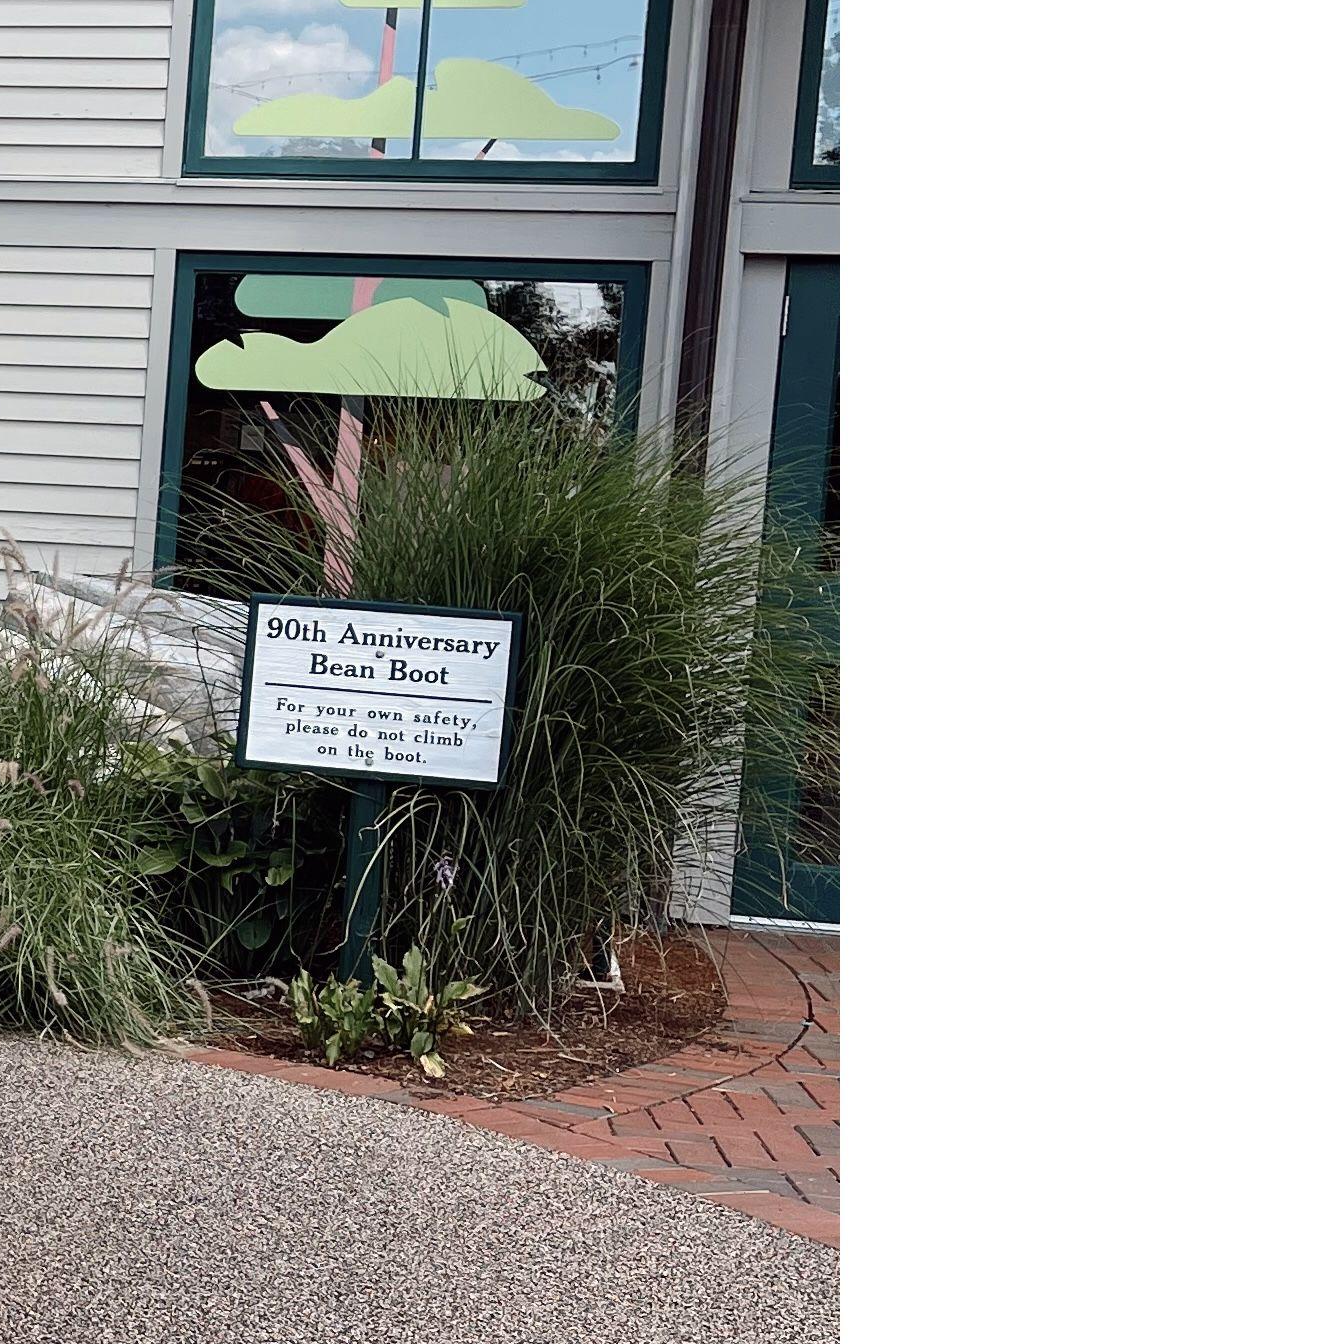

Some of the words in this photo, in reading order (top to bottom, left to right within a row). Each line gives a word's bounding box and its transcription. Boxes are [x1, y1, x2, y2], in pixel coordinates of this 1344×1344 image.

[266, 617, 327, 643] 90th
[338, 623, 500, 659] Anniversary
[309, 653, 375, 680] Bean
[388, 659, 449, 685] Boot
[276, 698, 305, 713] For
[316, 704, 356, 717] your
[367, 709, 403, 721] own
[413, 711, 478, 730] safety,
[285, 719, 339, 737] please
[347, 724, 368, 739] do
[377, 730, 405, 742] not
[414, 731, 464, 747] climb
[317, 744, 337, 756] on
[348, 745, 374, 759] the
[384, 747, 427, 764] boot.
